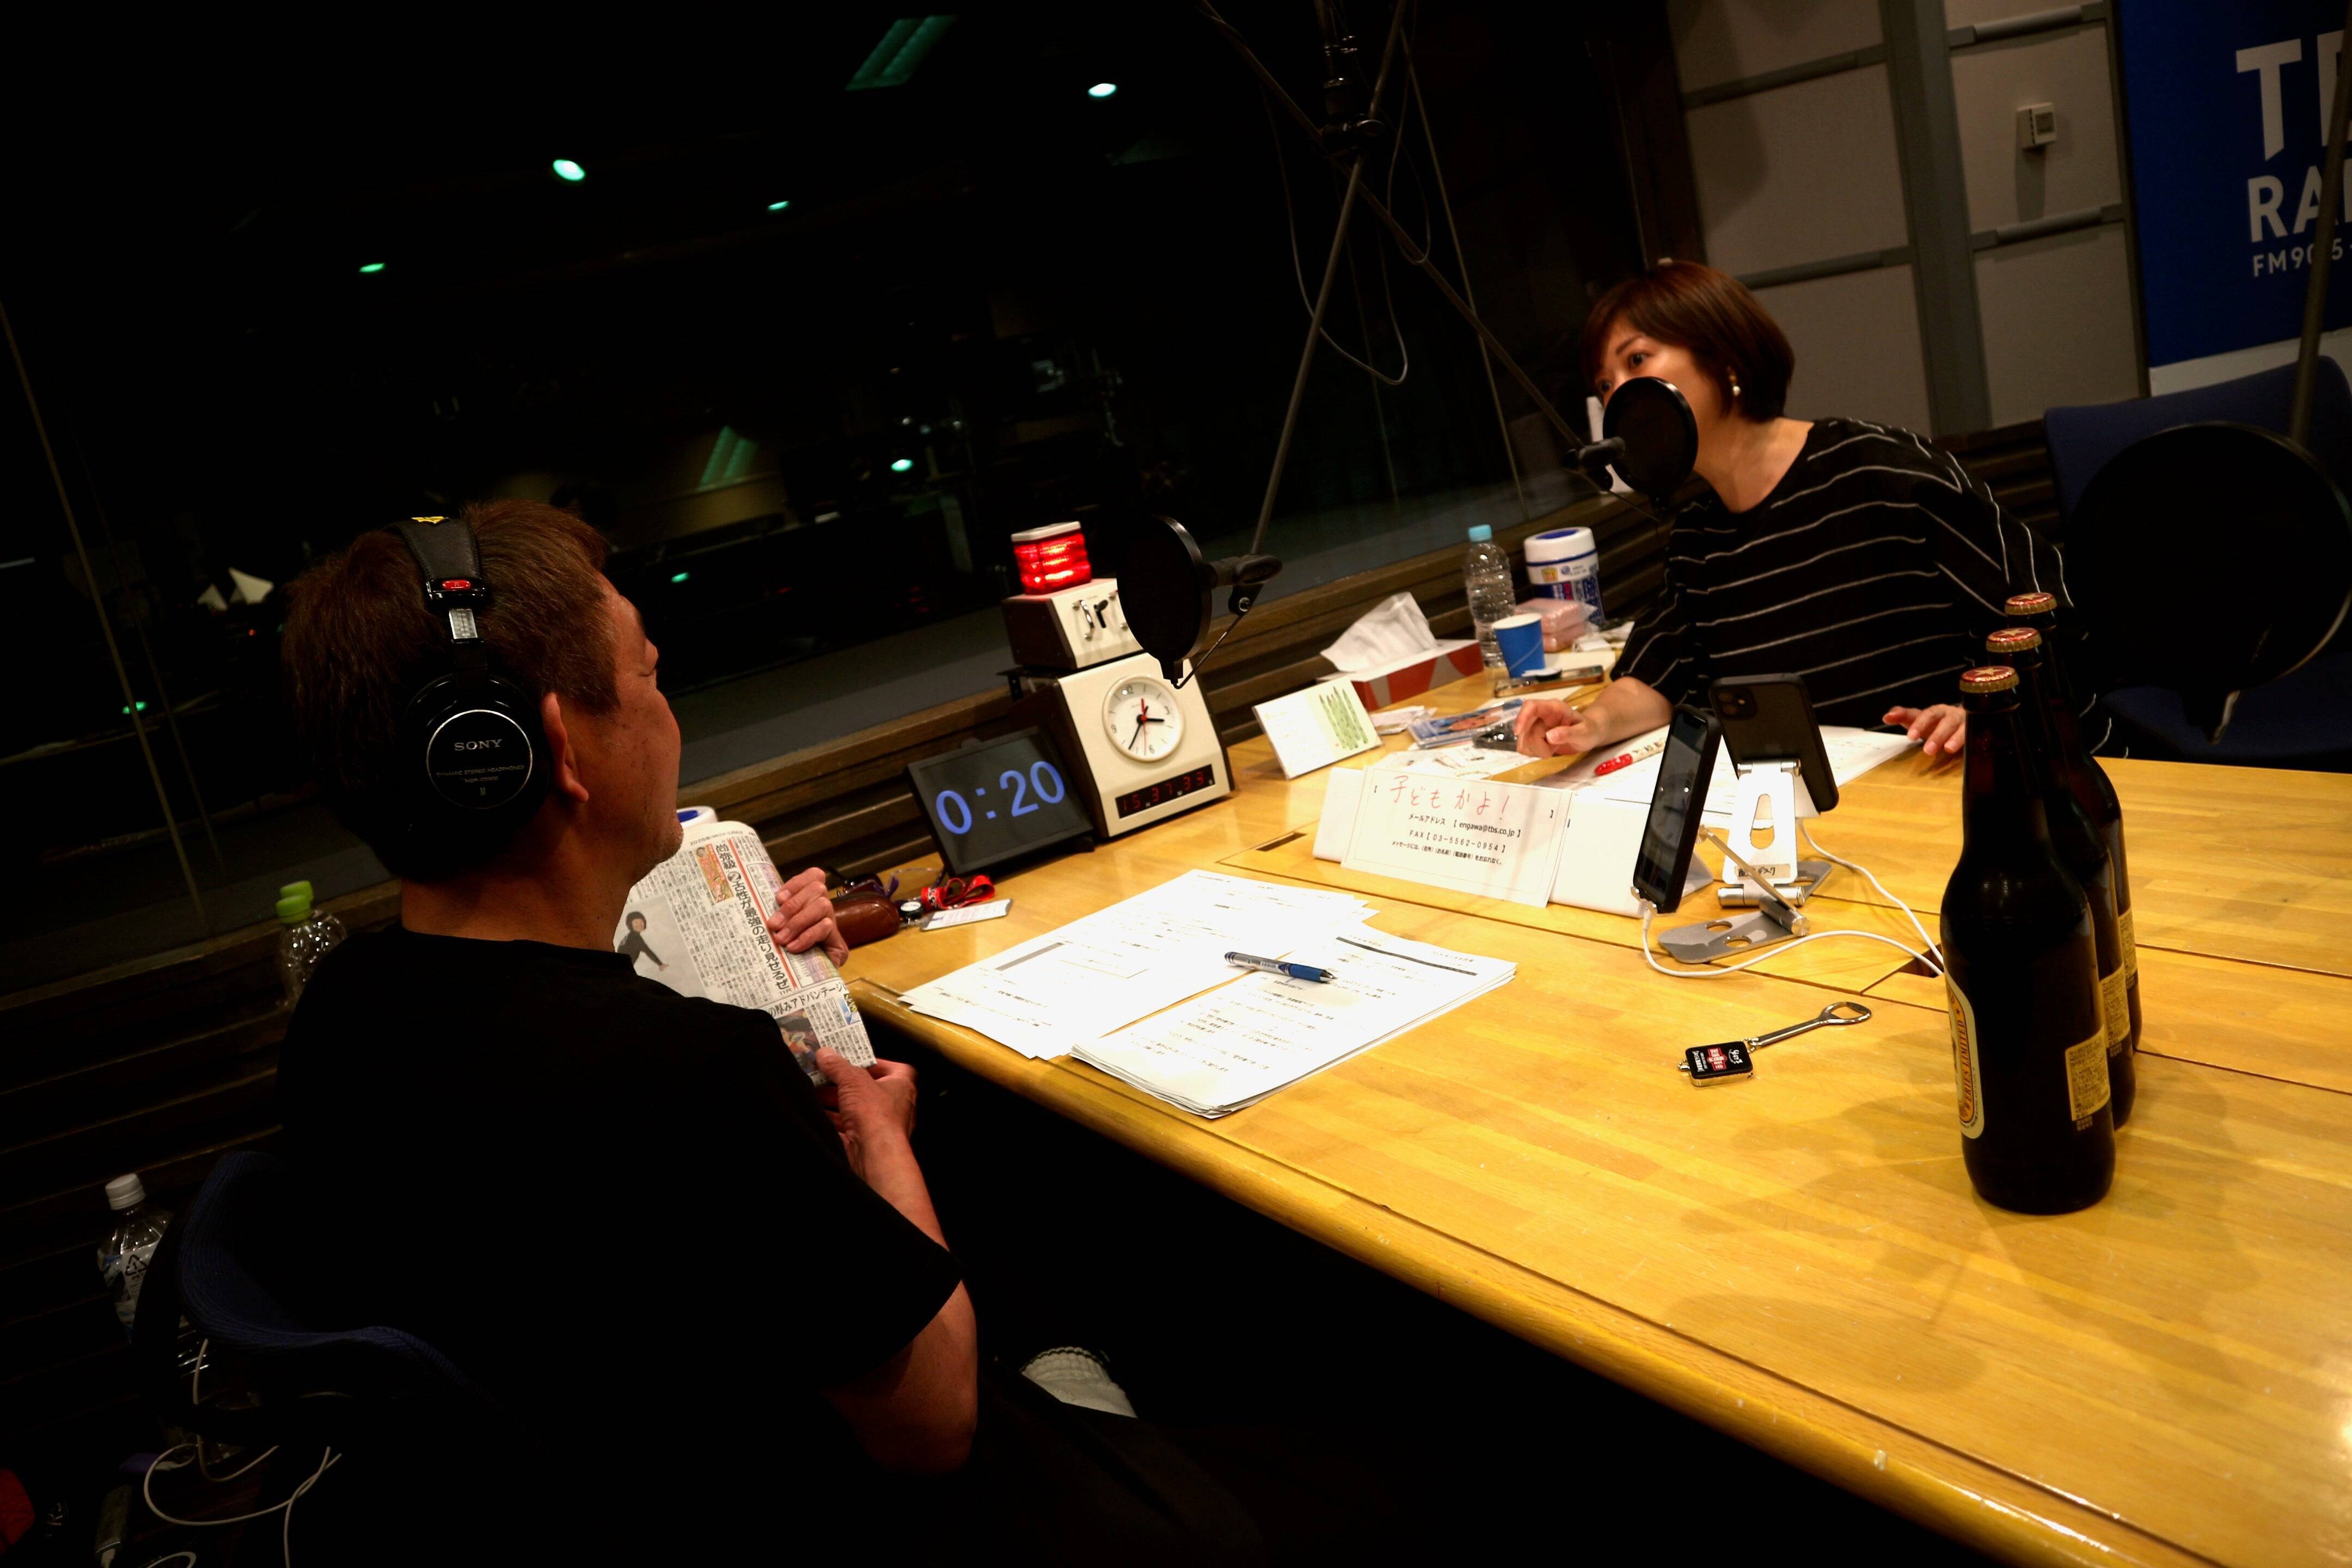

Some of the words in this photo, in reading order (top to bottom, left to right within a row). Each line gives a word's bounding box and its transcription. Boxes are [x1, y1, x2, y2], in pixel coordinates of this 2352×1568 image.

[2247, 158, 2352, 243] RA
[453, 739, 503, 751] SONY
[487, 765, 524, 773] HEADPHONES
[935, 760, 1065, 835] 0:20
[1408, 812, 1446, 826] メールアドレス
[1957, 1019, 1967, 1066] LIMITED
